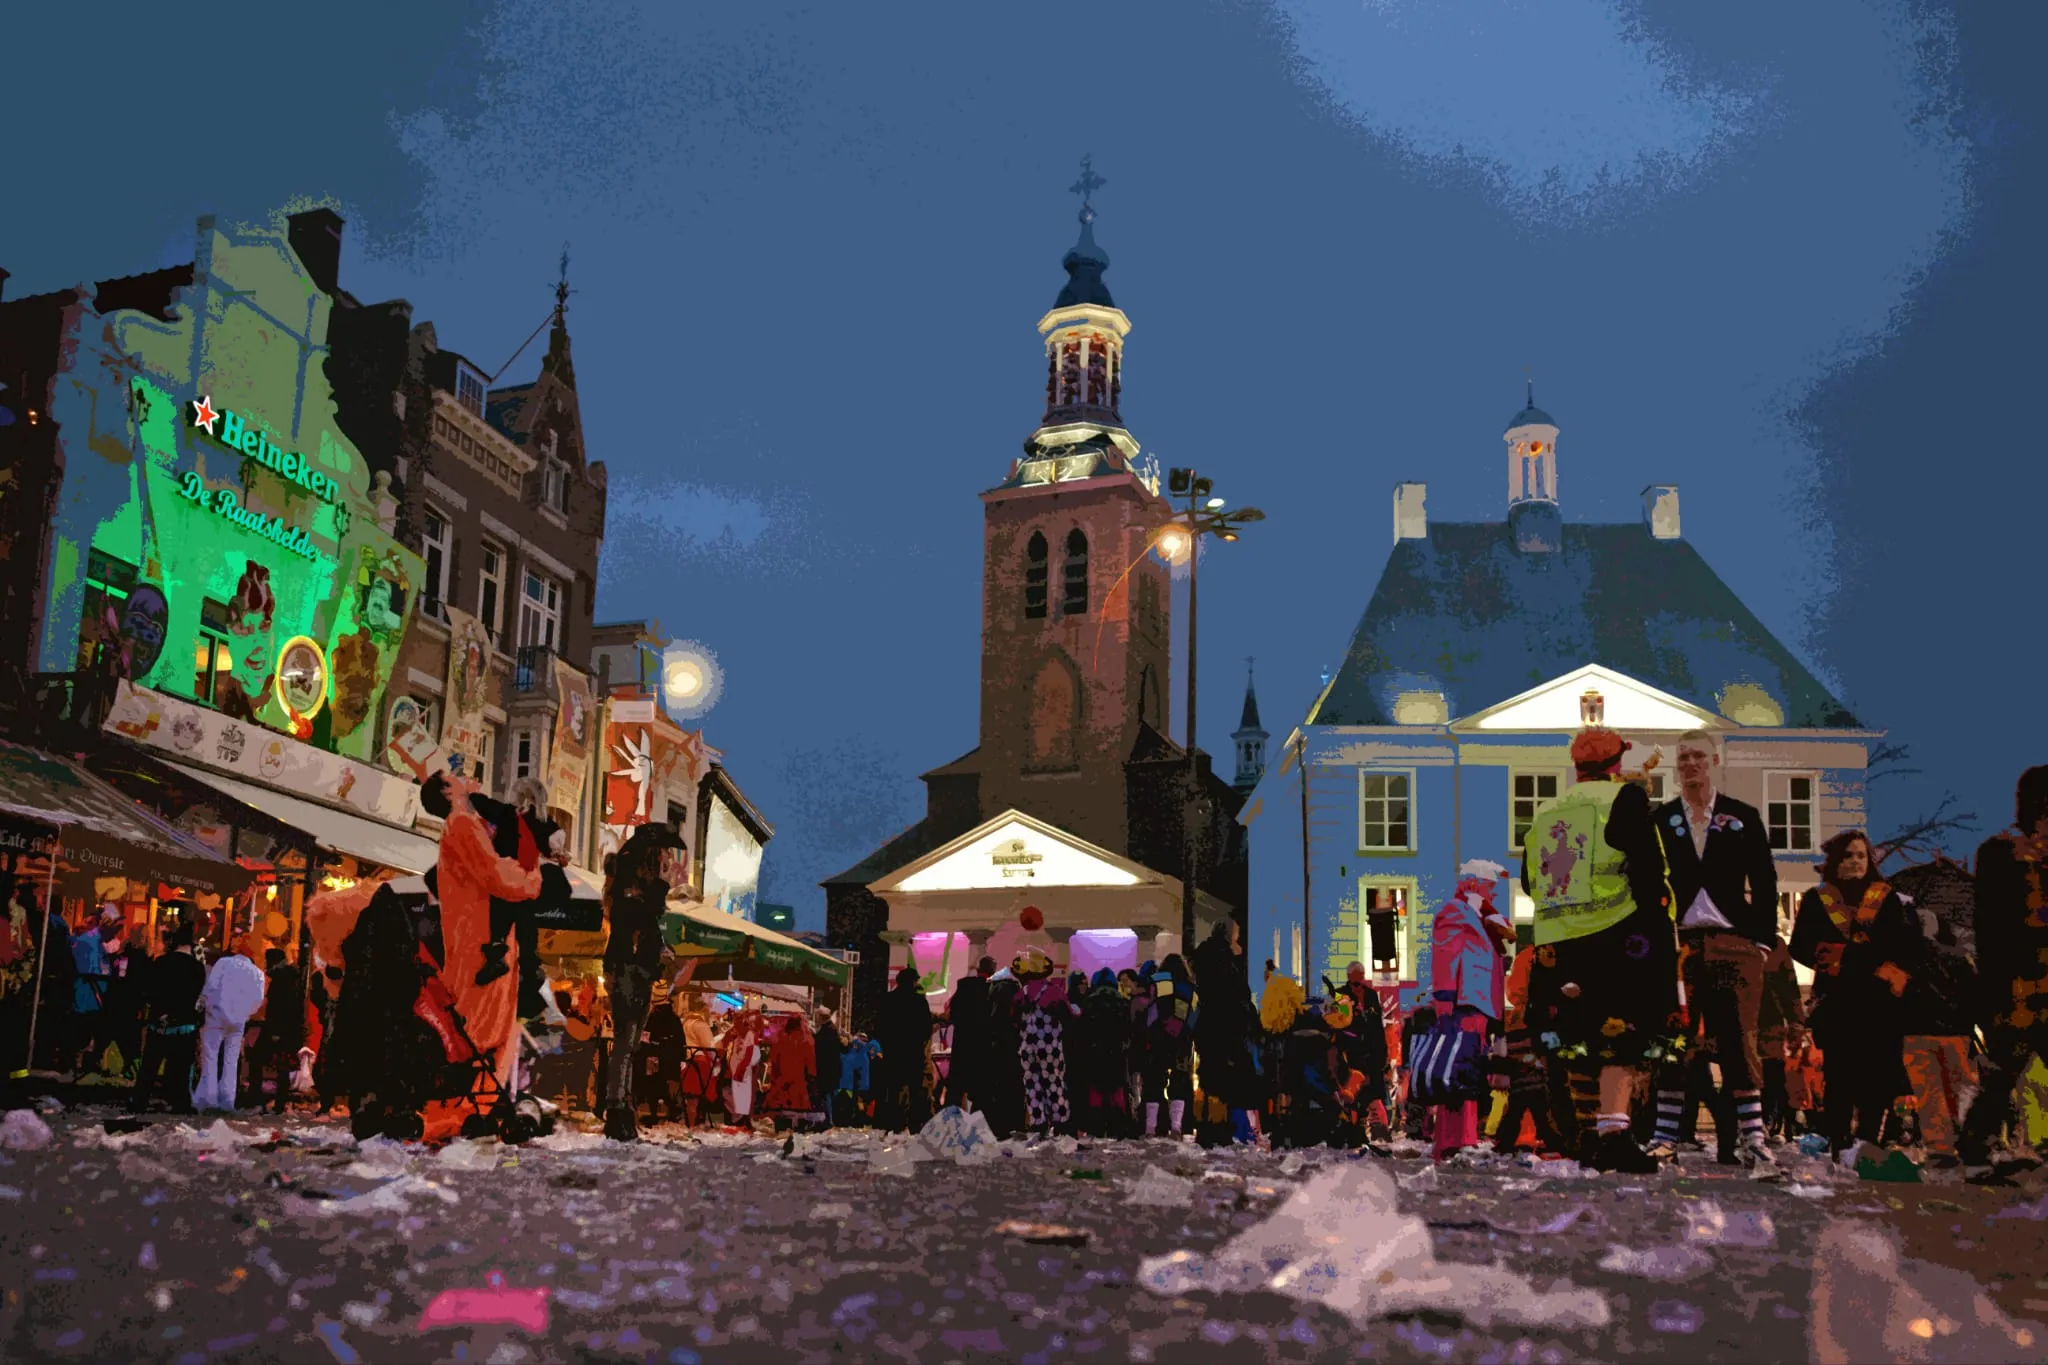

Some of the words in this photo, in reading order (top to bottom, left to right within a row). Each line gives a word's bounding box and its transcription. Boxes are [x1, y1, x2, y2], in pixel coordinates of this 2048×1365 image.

[221, 409, 339, 500] Heineken
[178, 471, 212, 507] De
[215, 489, 323, 562] Raatskelder
